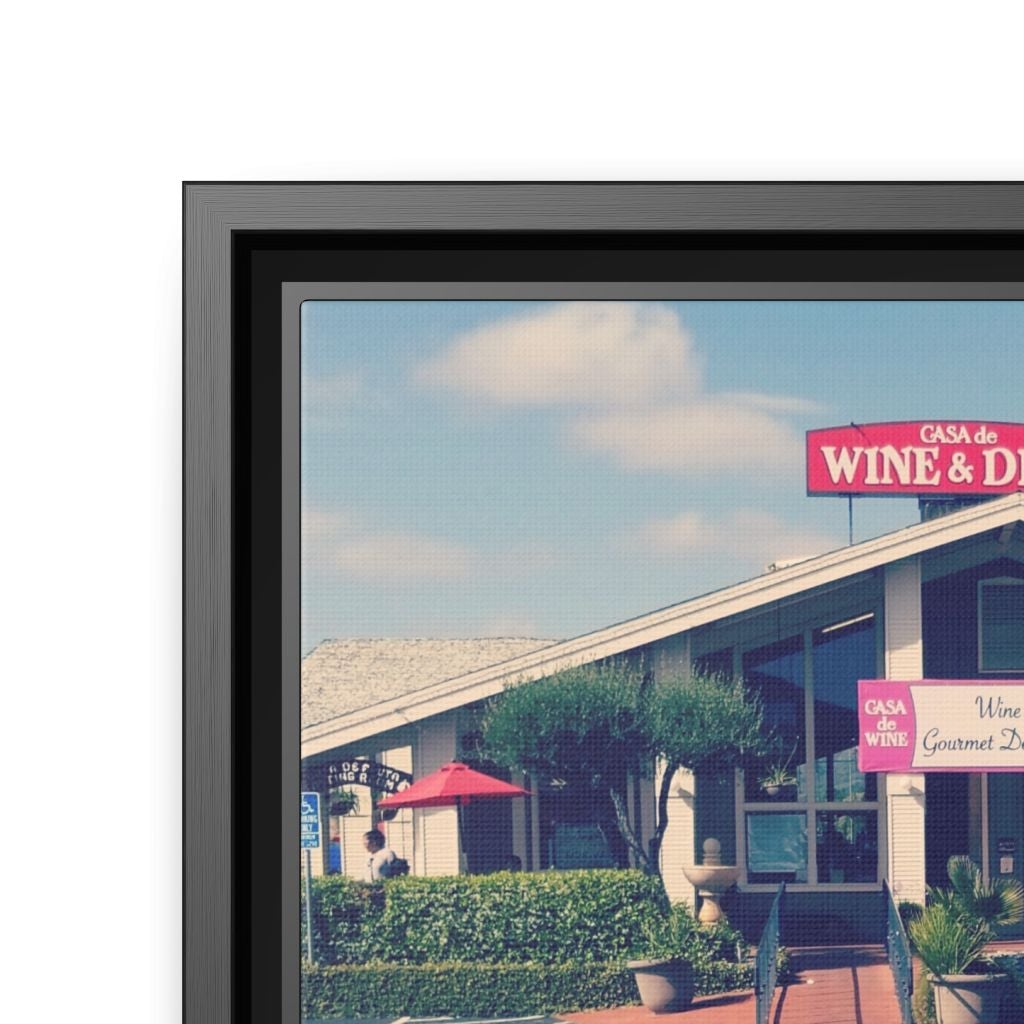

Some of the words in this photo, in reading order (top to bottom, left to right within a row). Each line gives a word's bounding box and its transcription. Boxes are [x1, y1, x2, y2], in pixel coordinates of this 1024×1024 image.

[919, 424, 971, 444] CASA
[974, 424, 998, 444] de
[820, 444, 942, 486] WINE
[947, 451, 974, 484] &
[864, 699, 908, 716] CASA
[974, 695, 1021, 719] Wine
[876, 715, 897, 731] de
[864, 732, 909, 748] WINE
[922, 727, 995, 758] Gourmet
